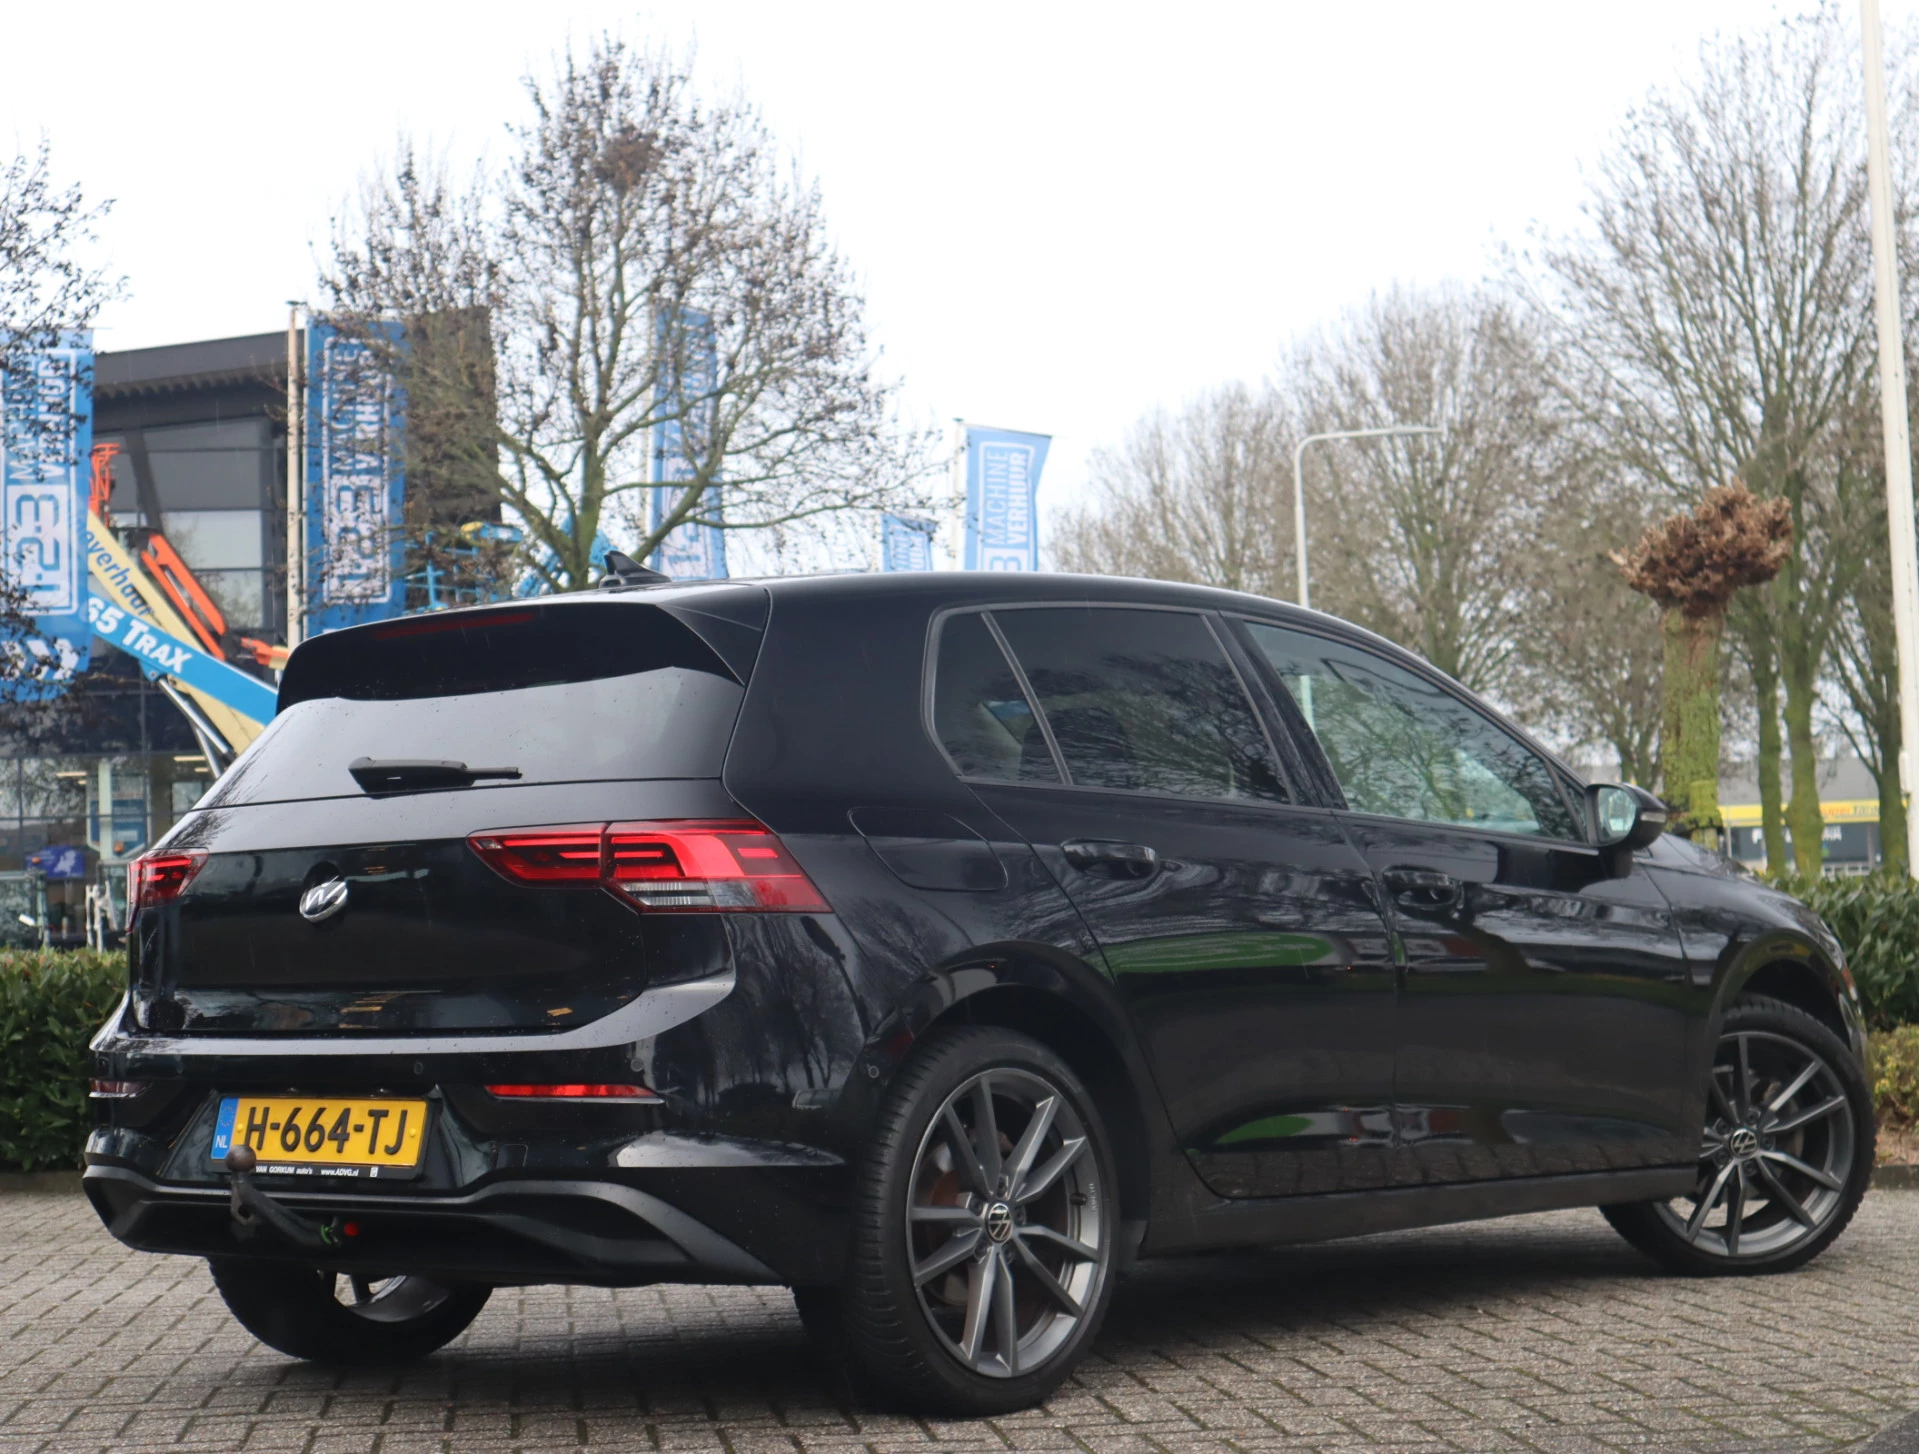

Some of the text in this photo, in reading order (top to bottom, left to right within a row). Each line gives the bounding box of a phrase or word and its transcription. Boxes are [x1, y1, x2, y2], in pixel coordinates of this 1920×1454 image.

[985, 450, 1009, 545] MACHINE
[1007, 452, 1028, 545] VERHUUR
[215, 1135, 228, 1149] NL
[244, 1106, 408, 1156] H-664-TJ
[255, 1165, 359, 1177] VAN GORKUM auto's www.ADVG.nl
